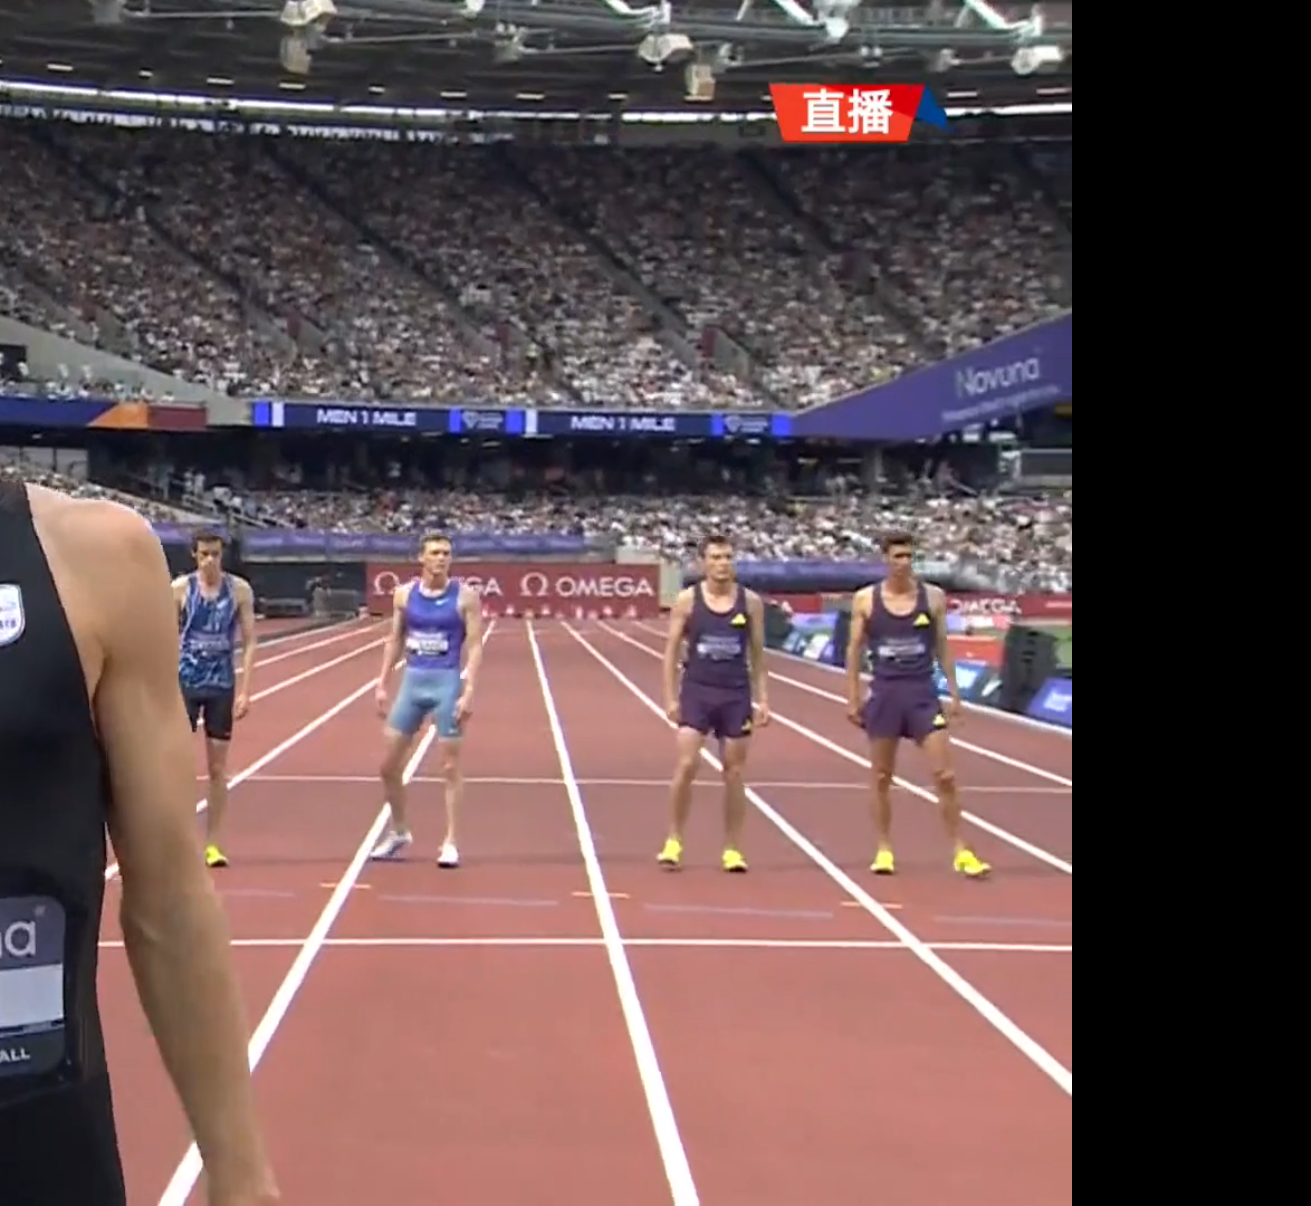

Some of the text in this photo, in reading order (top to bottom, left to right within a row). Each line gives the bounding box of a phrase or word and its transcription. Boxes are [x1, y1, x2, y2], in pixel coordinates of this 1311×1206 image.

[956, 357, 1041, 397] Novuna
[316, 408, 417, 427] MEN 1 MILE
[570, 415, 614, 431] MEN
[629, 416, 676, 432] MILE
[555, 576, 654, 597] OMEGA
